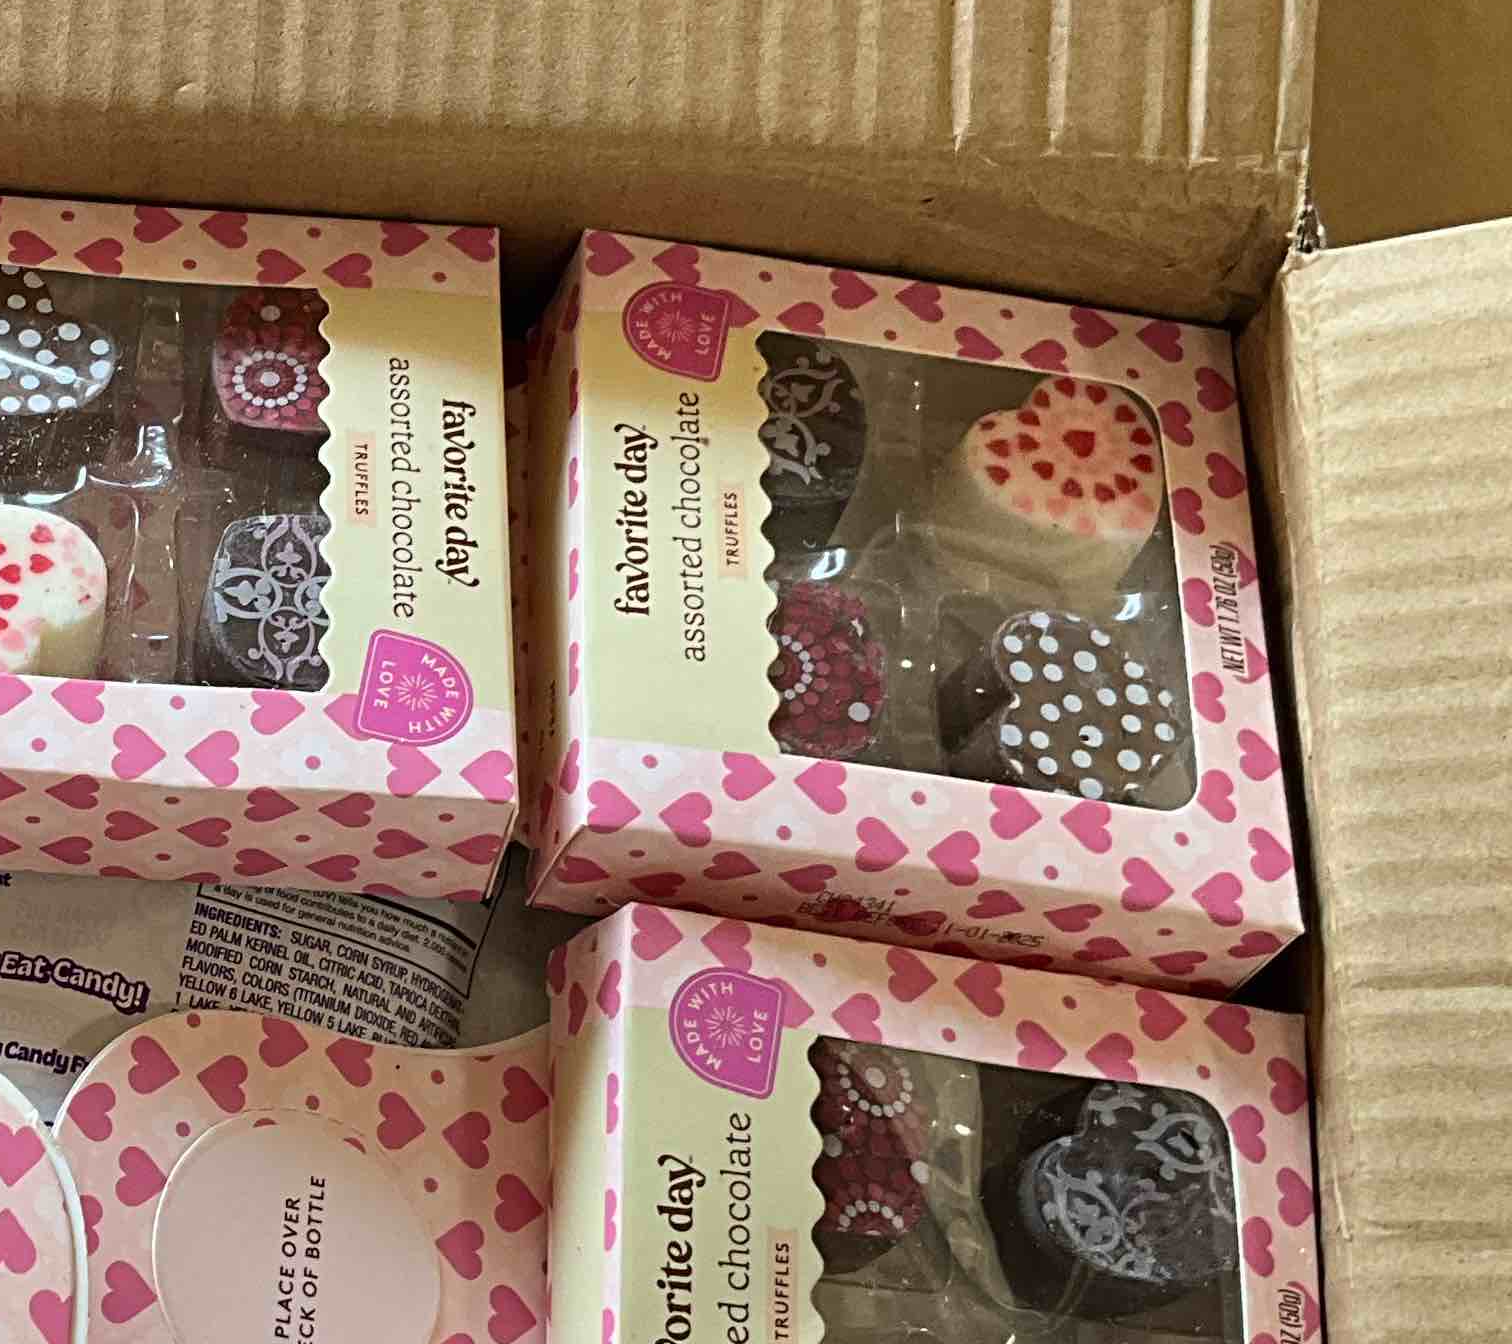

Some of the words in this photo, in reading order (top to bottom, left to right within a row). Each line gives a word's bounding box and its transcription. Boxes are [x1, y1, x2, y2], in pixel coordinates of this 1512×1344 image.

[694, 312, 715, 355] LOVE
[388, 357, 421, 472] assorted
[351, 442, 369, 516] TRUFFLES
[442, 399, 477, 521] favorite
[614, 423, 659, 486] day
[671, 390, 705, 530] chocolate
[390, 479, 423, 620] chocolate
[435, 522, 479, 587] day
[615, 486, 650, 618] favorite
[725, 492, 740, 568] TRUFFLES
[672, 537, 705, 662] assorted
[373, 660, 396, 708] LOVE
[421, 653, 460, 698] MADE
[409, 707, 456, 733] WITH
[195, 903, 282, 939] INGREDIENTS:
[290, 931, 332, 954] SUGAR,
[337, 944, 369, 966] CORN
[0, 953, 44, 976] Eat
[53, 961, 146, 1010] Candy!
[688, 982, 734, 1010] WITH
[5, 1041, 69, 1073] Candy
[684, 1019, 722, 1070] MADE
[747, 1008, 768, 1063] LOVE
[306, 1176, 326, 1260] BOTTLE
[657, 1153, 707, 1233] day
[718, 1111, 751, 1291] chocolate
[282, 1197, 301, 1257] OVER
[275, 1266, 295, 1339] PLACE
[303, 1266, 318, 1297] OF
[776, 1242, 789, 1342] TRUFFLES
[1277, 1288, 1302, 1328] (50g)
